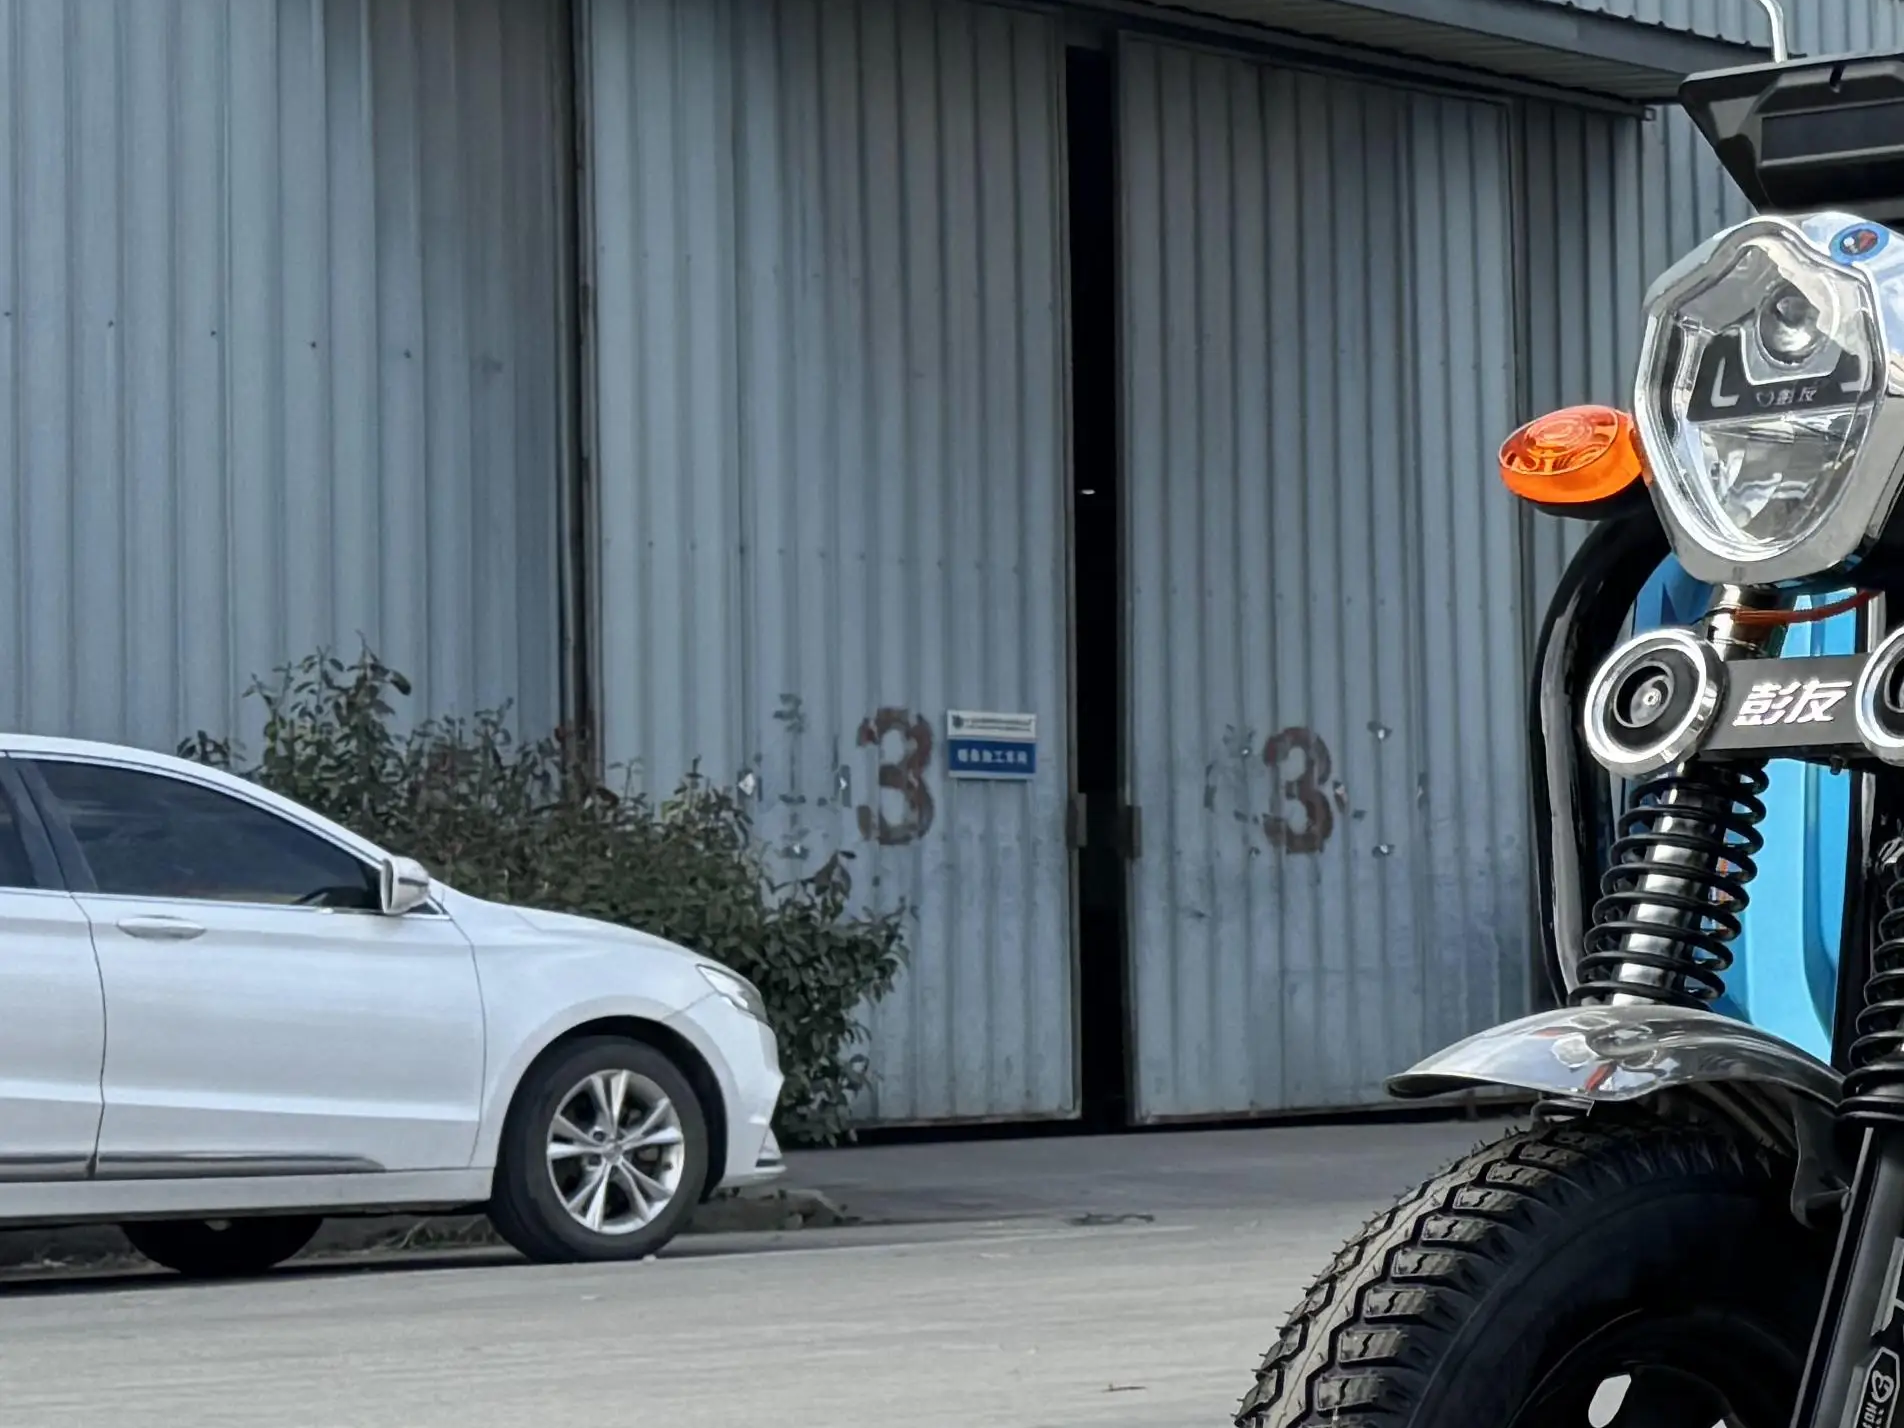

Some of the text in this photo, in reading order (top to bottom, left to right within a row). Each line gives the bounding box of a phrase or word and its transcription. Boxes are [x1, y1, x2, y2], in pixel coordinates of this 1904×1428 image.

[1732, 678, 1853, 726] 彭友
[857, 706, 933, 846] 3
[1263, 726, 1333, 855] 3
